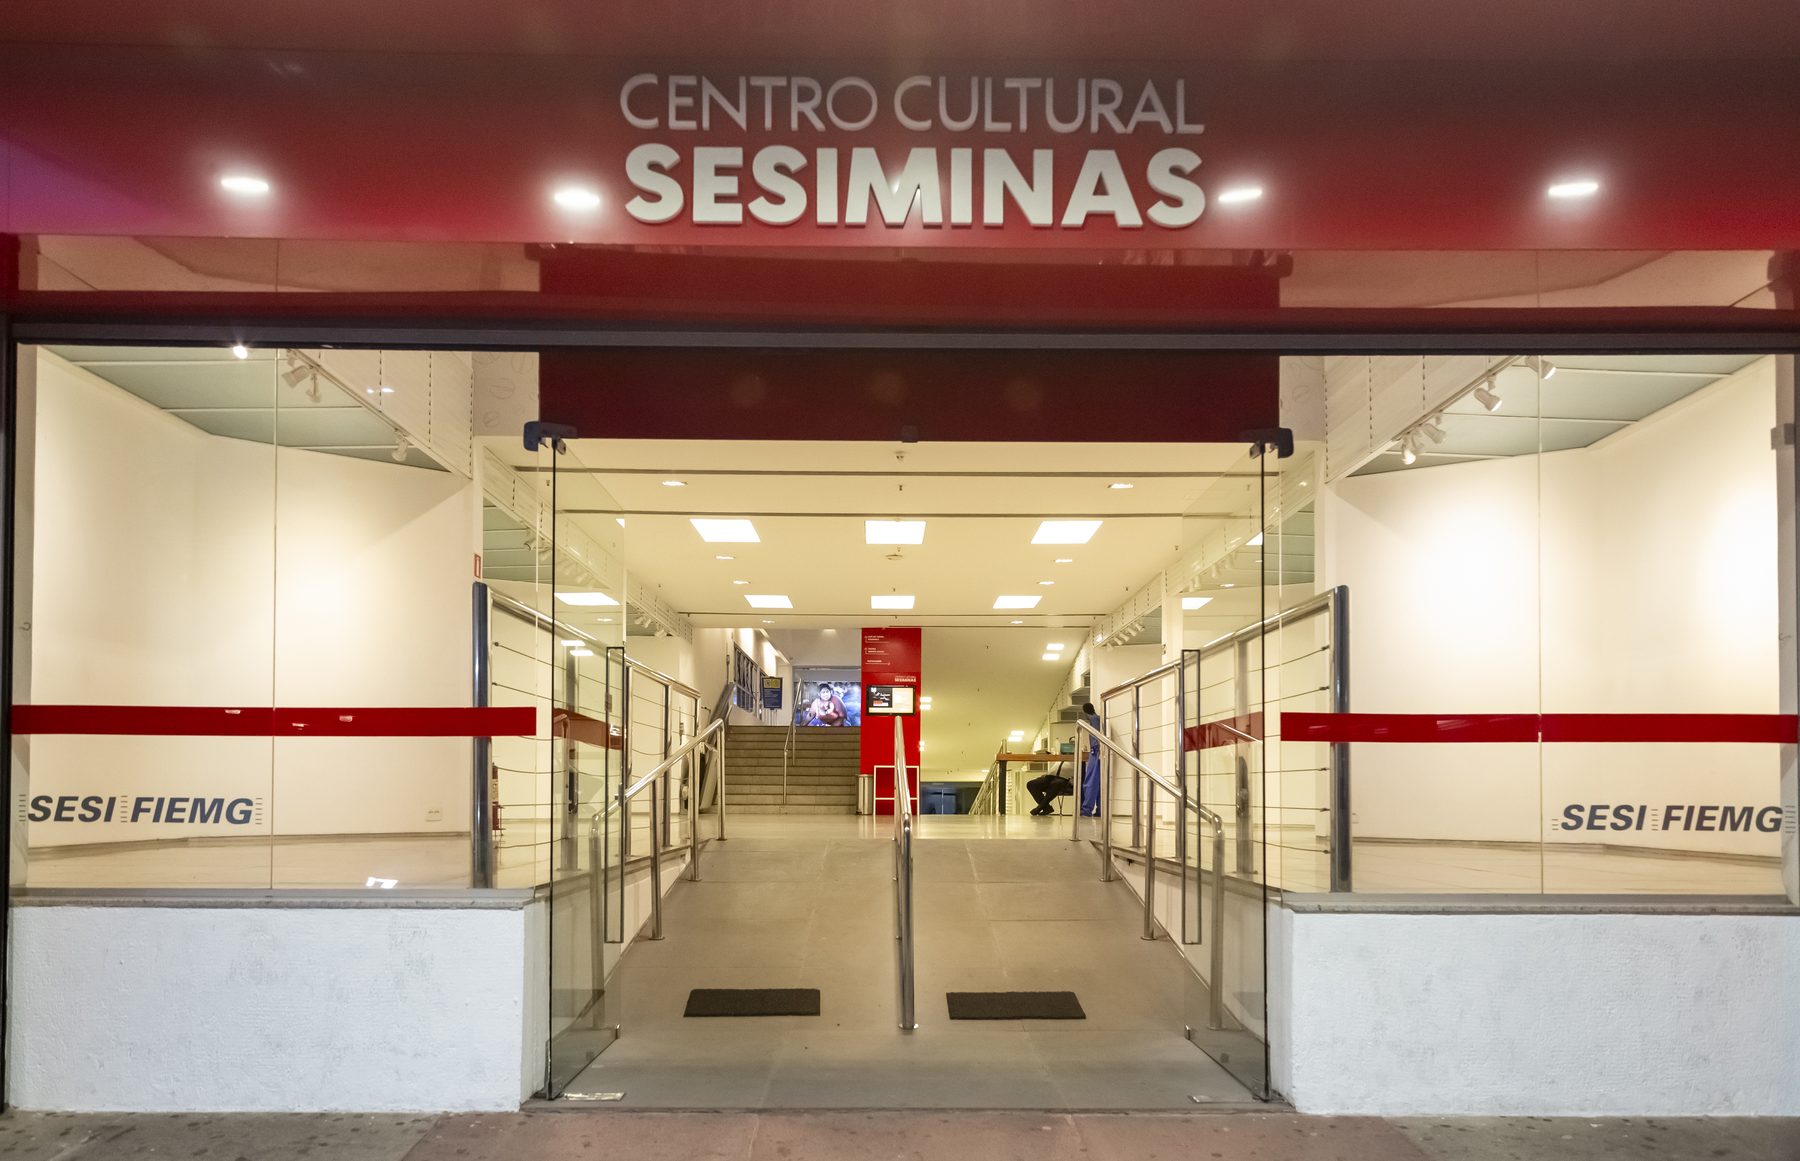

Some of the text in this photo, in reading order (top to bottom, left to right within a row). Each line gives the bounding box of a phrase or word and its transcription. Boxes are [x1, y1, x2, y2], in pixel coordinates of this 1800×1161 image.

[619, 73, 1205, 135] CENTRO CULTURAL
[624, 143, 1206, 229] SESIMINAS
[28, 795, 254, 825] SESI FIEMG
[1560, 804, 1783, 832] SESI FIEMG
